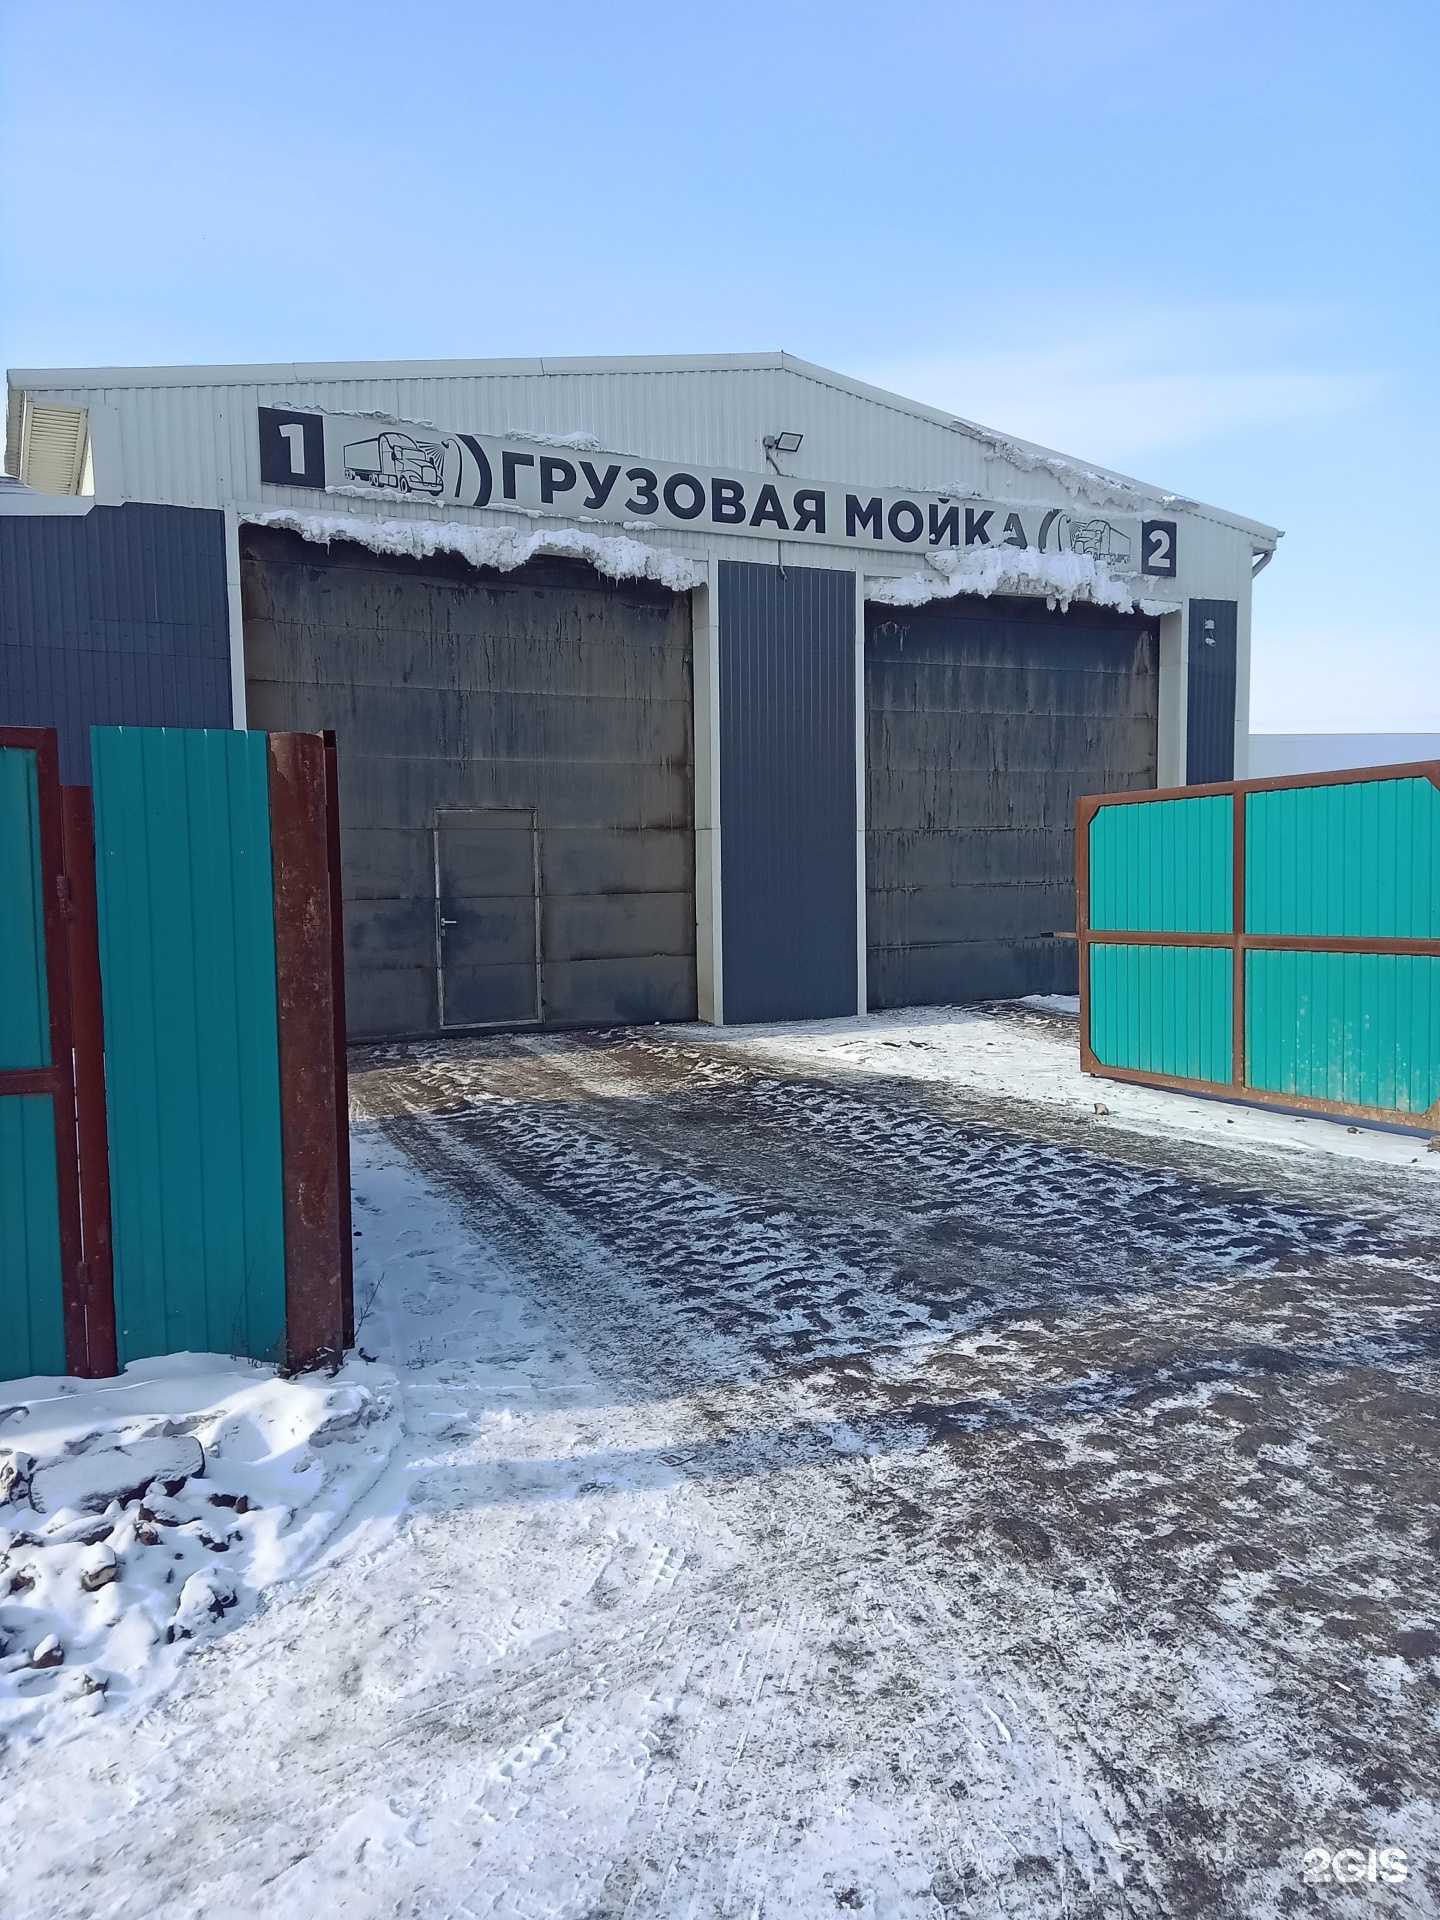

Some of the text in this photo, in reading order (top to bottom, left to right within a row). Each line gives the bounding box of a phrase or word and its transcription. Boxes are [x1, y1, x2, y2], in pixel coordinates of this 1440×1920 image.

[278, 423, 306, 475] 1
[502, 450, 1028, 550] ГРУЗОВАЯ МОЙКА
[1147, 529, 1172, 568] 2
